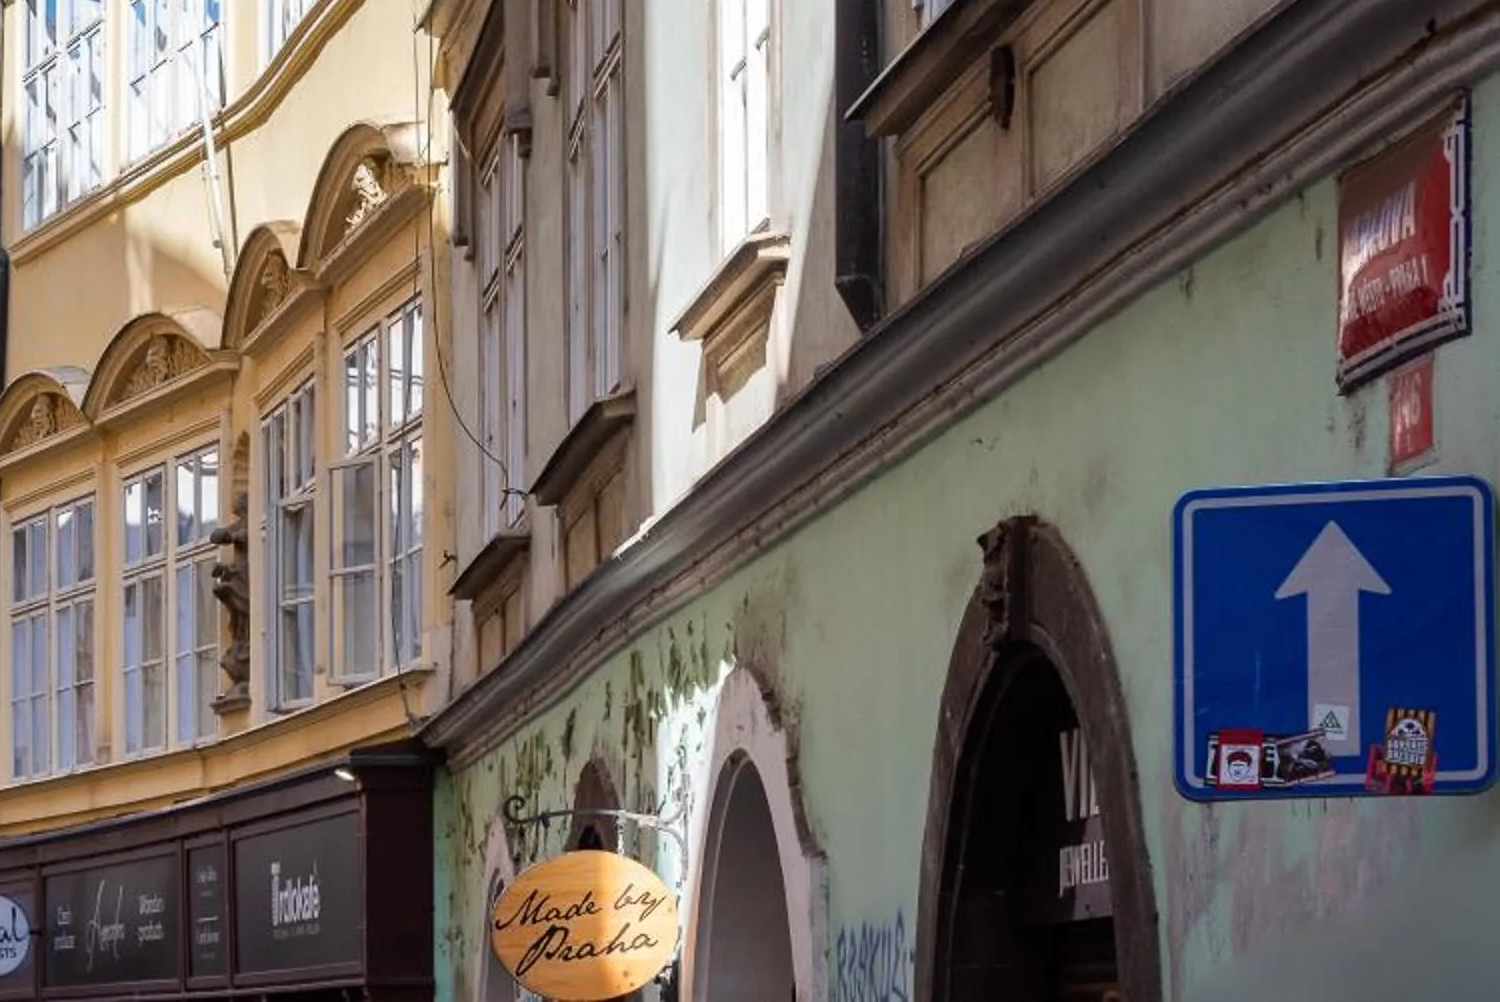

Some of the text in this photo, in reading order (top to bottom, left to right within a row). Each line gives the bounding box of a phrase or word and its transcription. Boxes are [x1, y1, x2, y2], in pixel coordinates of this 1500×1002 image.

[1342, 180, 1416, 275] RLOVA
[495, 883, 667, 930] Made by
[516, 921, 659, 977] Praha
